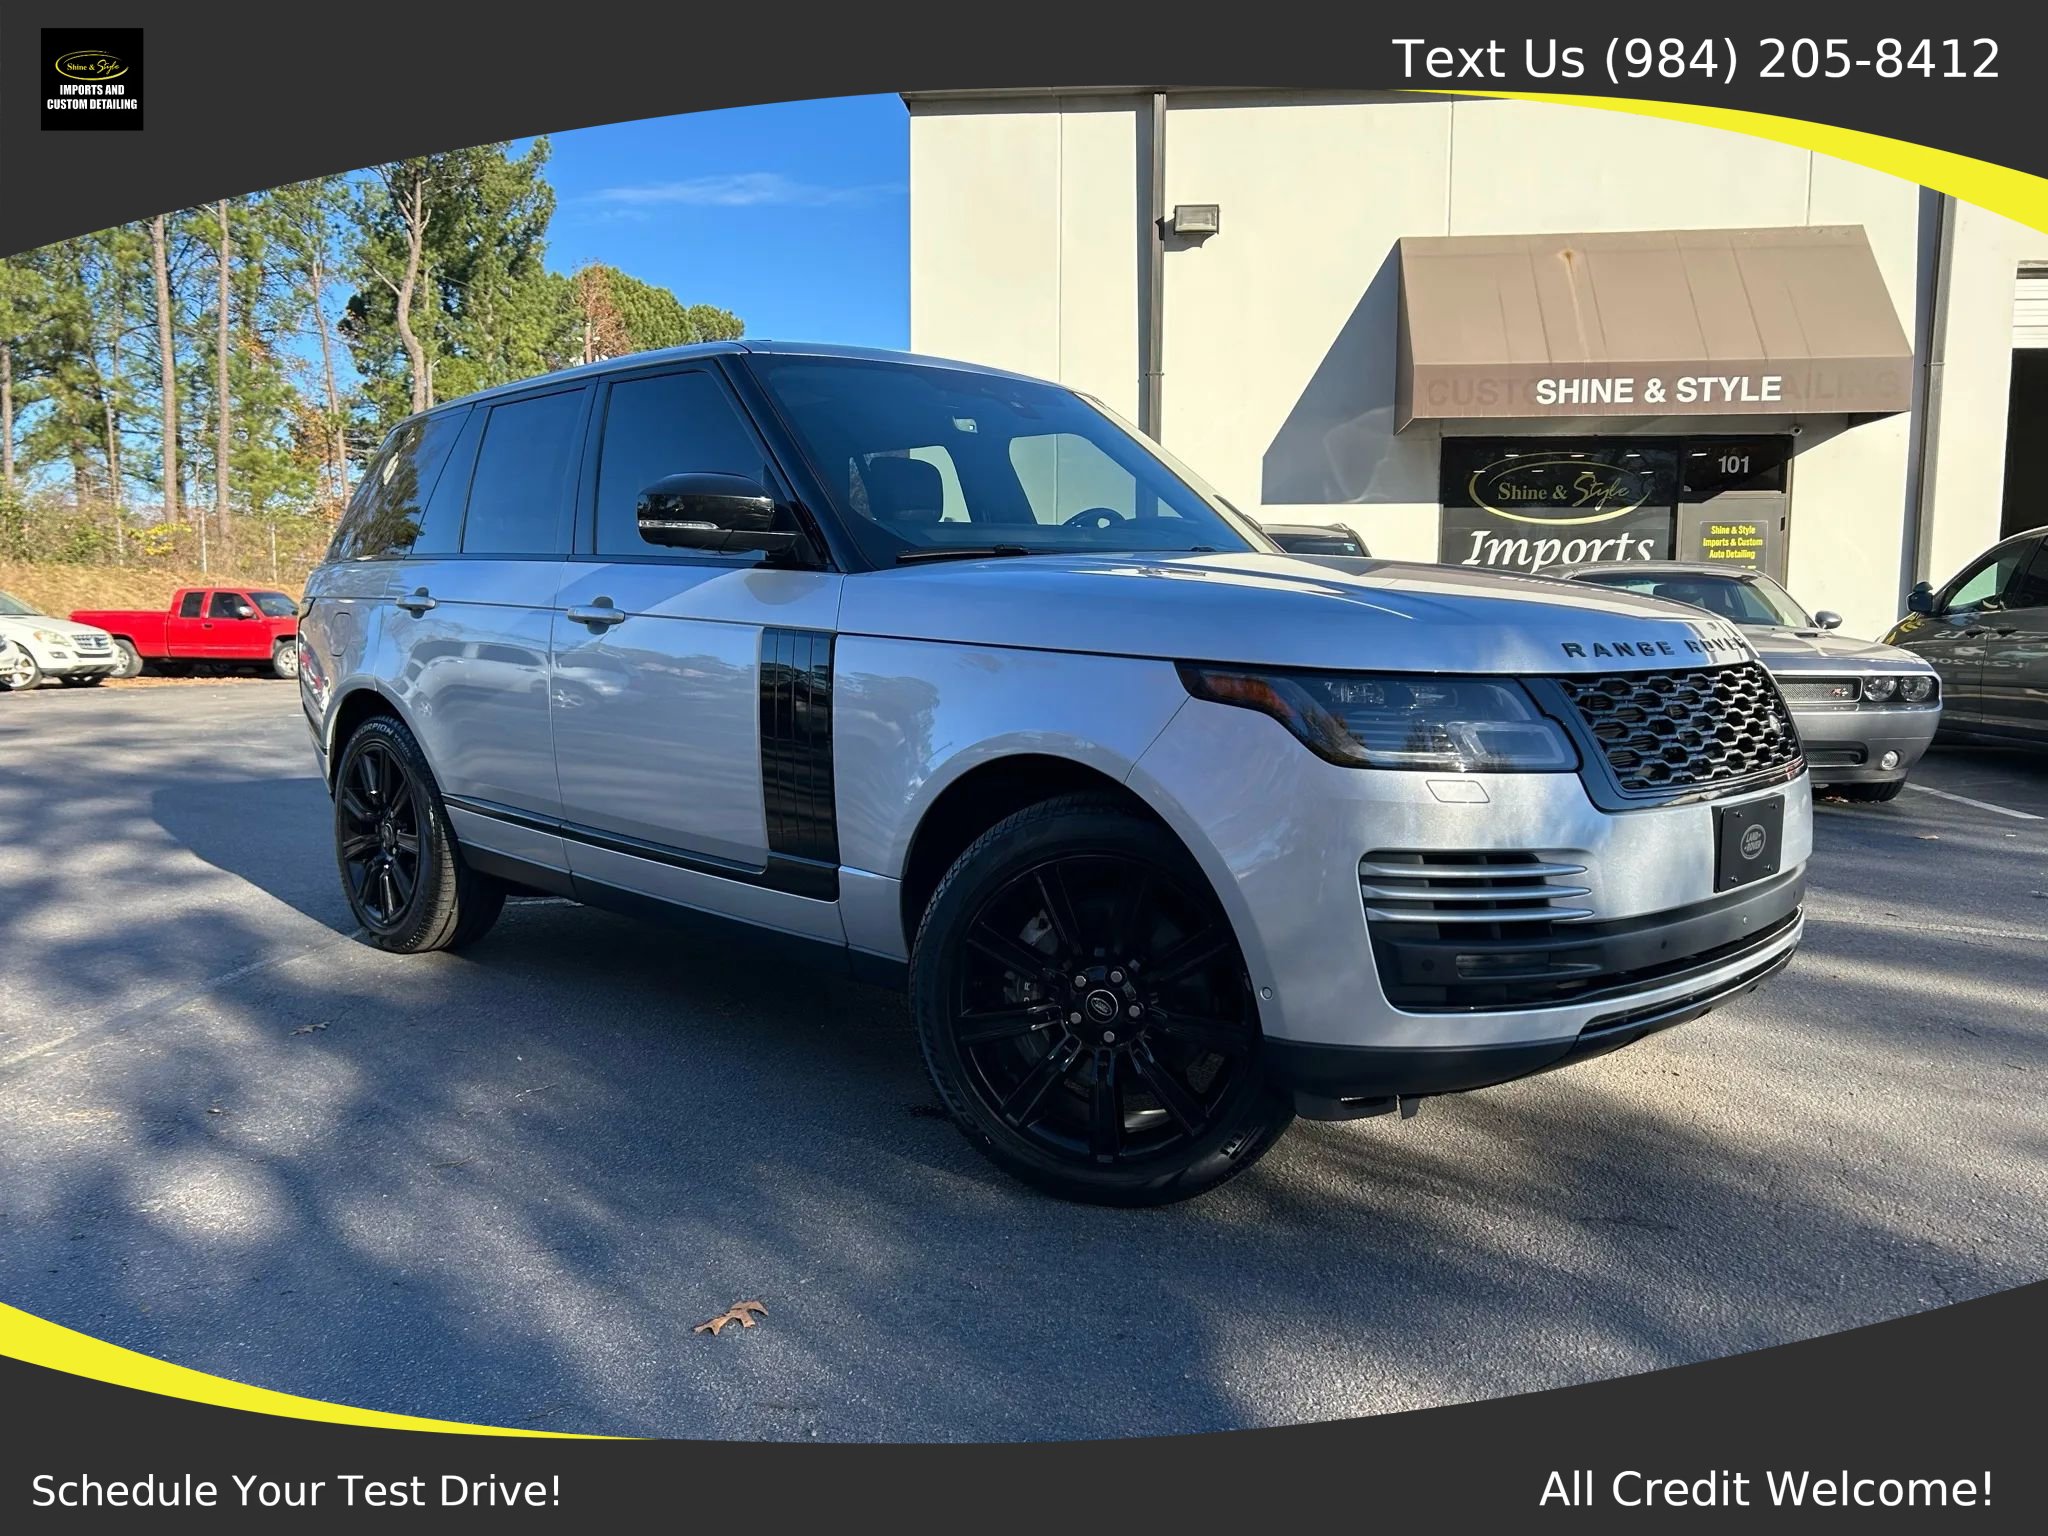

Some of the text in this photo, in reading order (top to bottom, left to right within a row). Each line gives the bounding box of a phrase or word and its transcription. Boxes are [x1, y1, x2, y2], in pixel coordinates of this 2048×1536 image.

[1536, 376, 1782, 405] SHINE & STYLE
[1718, 455, 1749, 474] 101
[1498, 472, 1631, 512] Shine & Style
[1711, 525, 1756, 536] Shine & Style
[1702, 537, 1763, 547] Imports & Custom
[1461, 530, 1655, 575] Imports
[1709, 549, 1756, 560] Auto Detailing
[1561, 636, 1748, 658] RANGE ROVER
